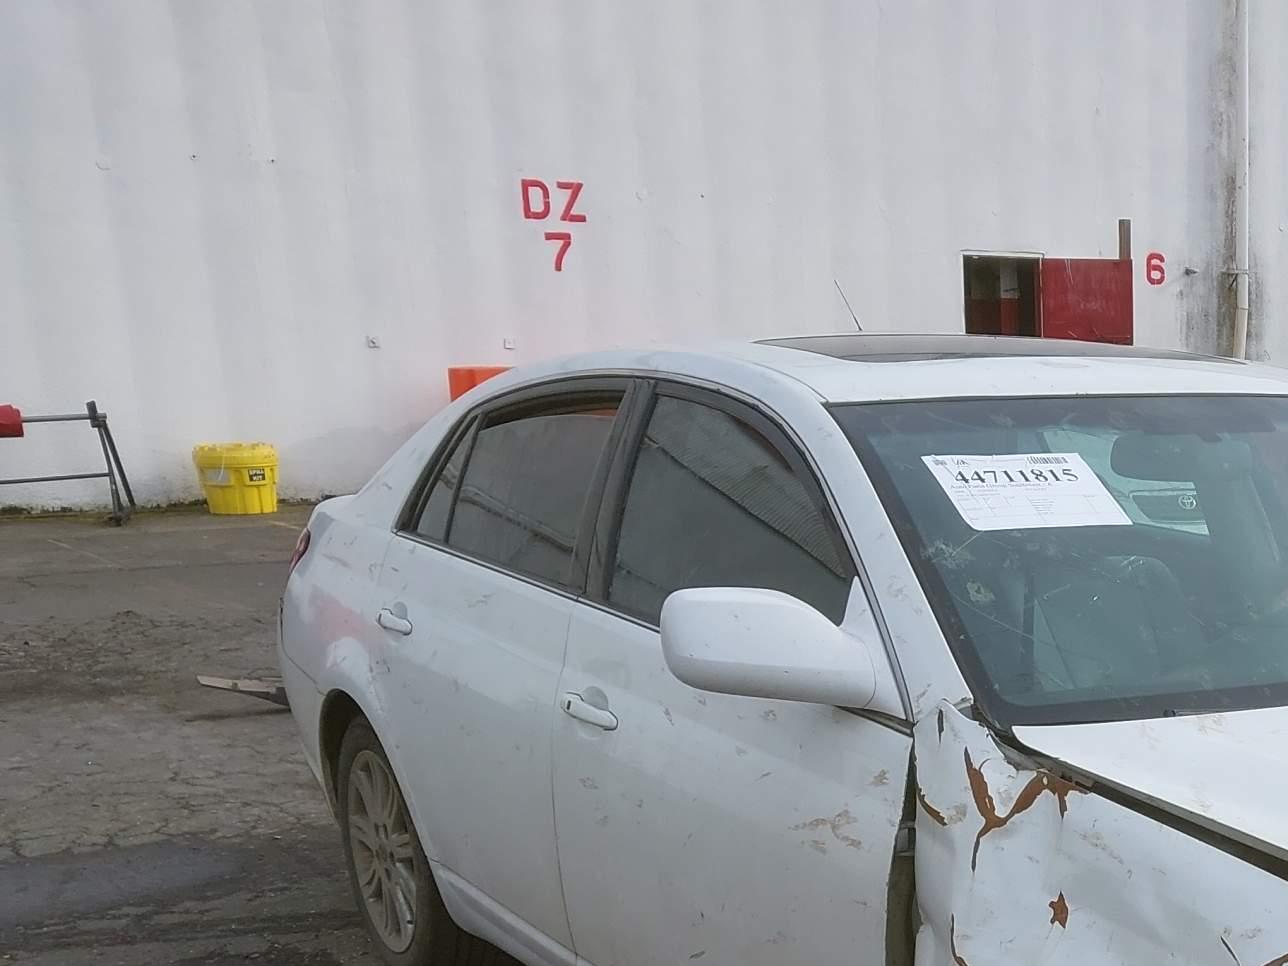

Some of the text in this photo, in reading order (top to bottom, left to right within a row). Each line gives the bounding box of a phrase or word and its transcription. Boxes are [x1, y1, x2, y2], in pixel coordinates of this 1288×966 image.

[520, 178, 587, 223] DZ
[544, 231, 572, 272] 7
[1146, 252, 1166, 286] 6
[954, 468, 1079, 484] 44711815
